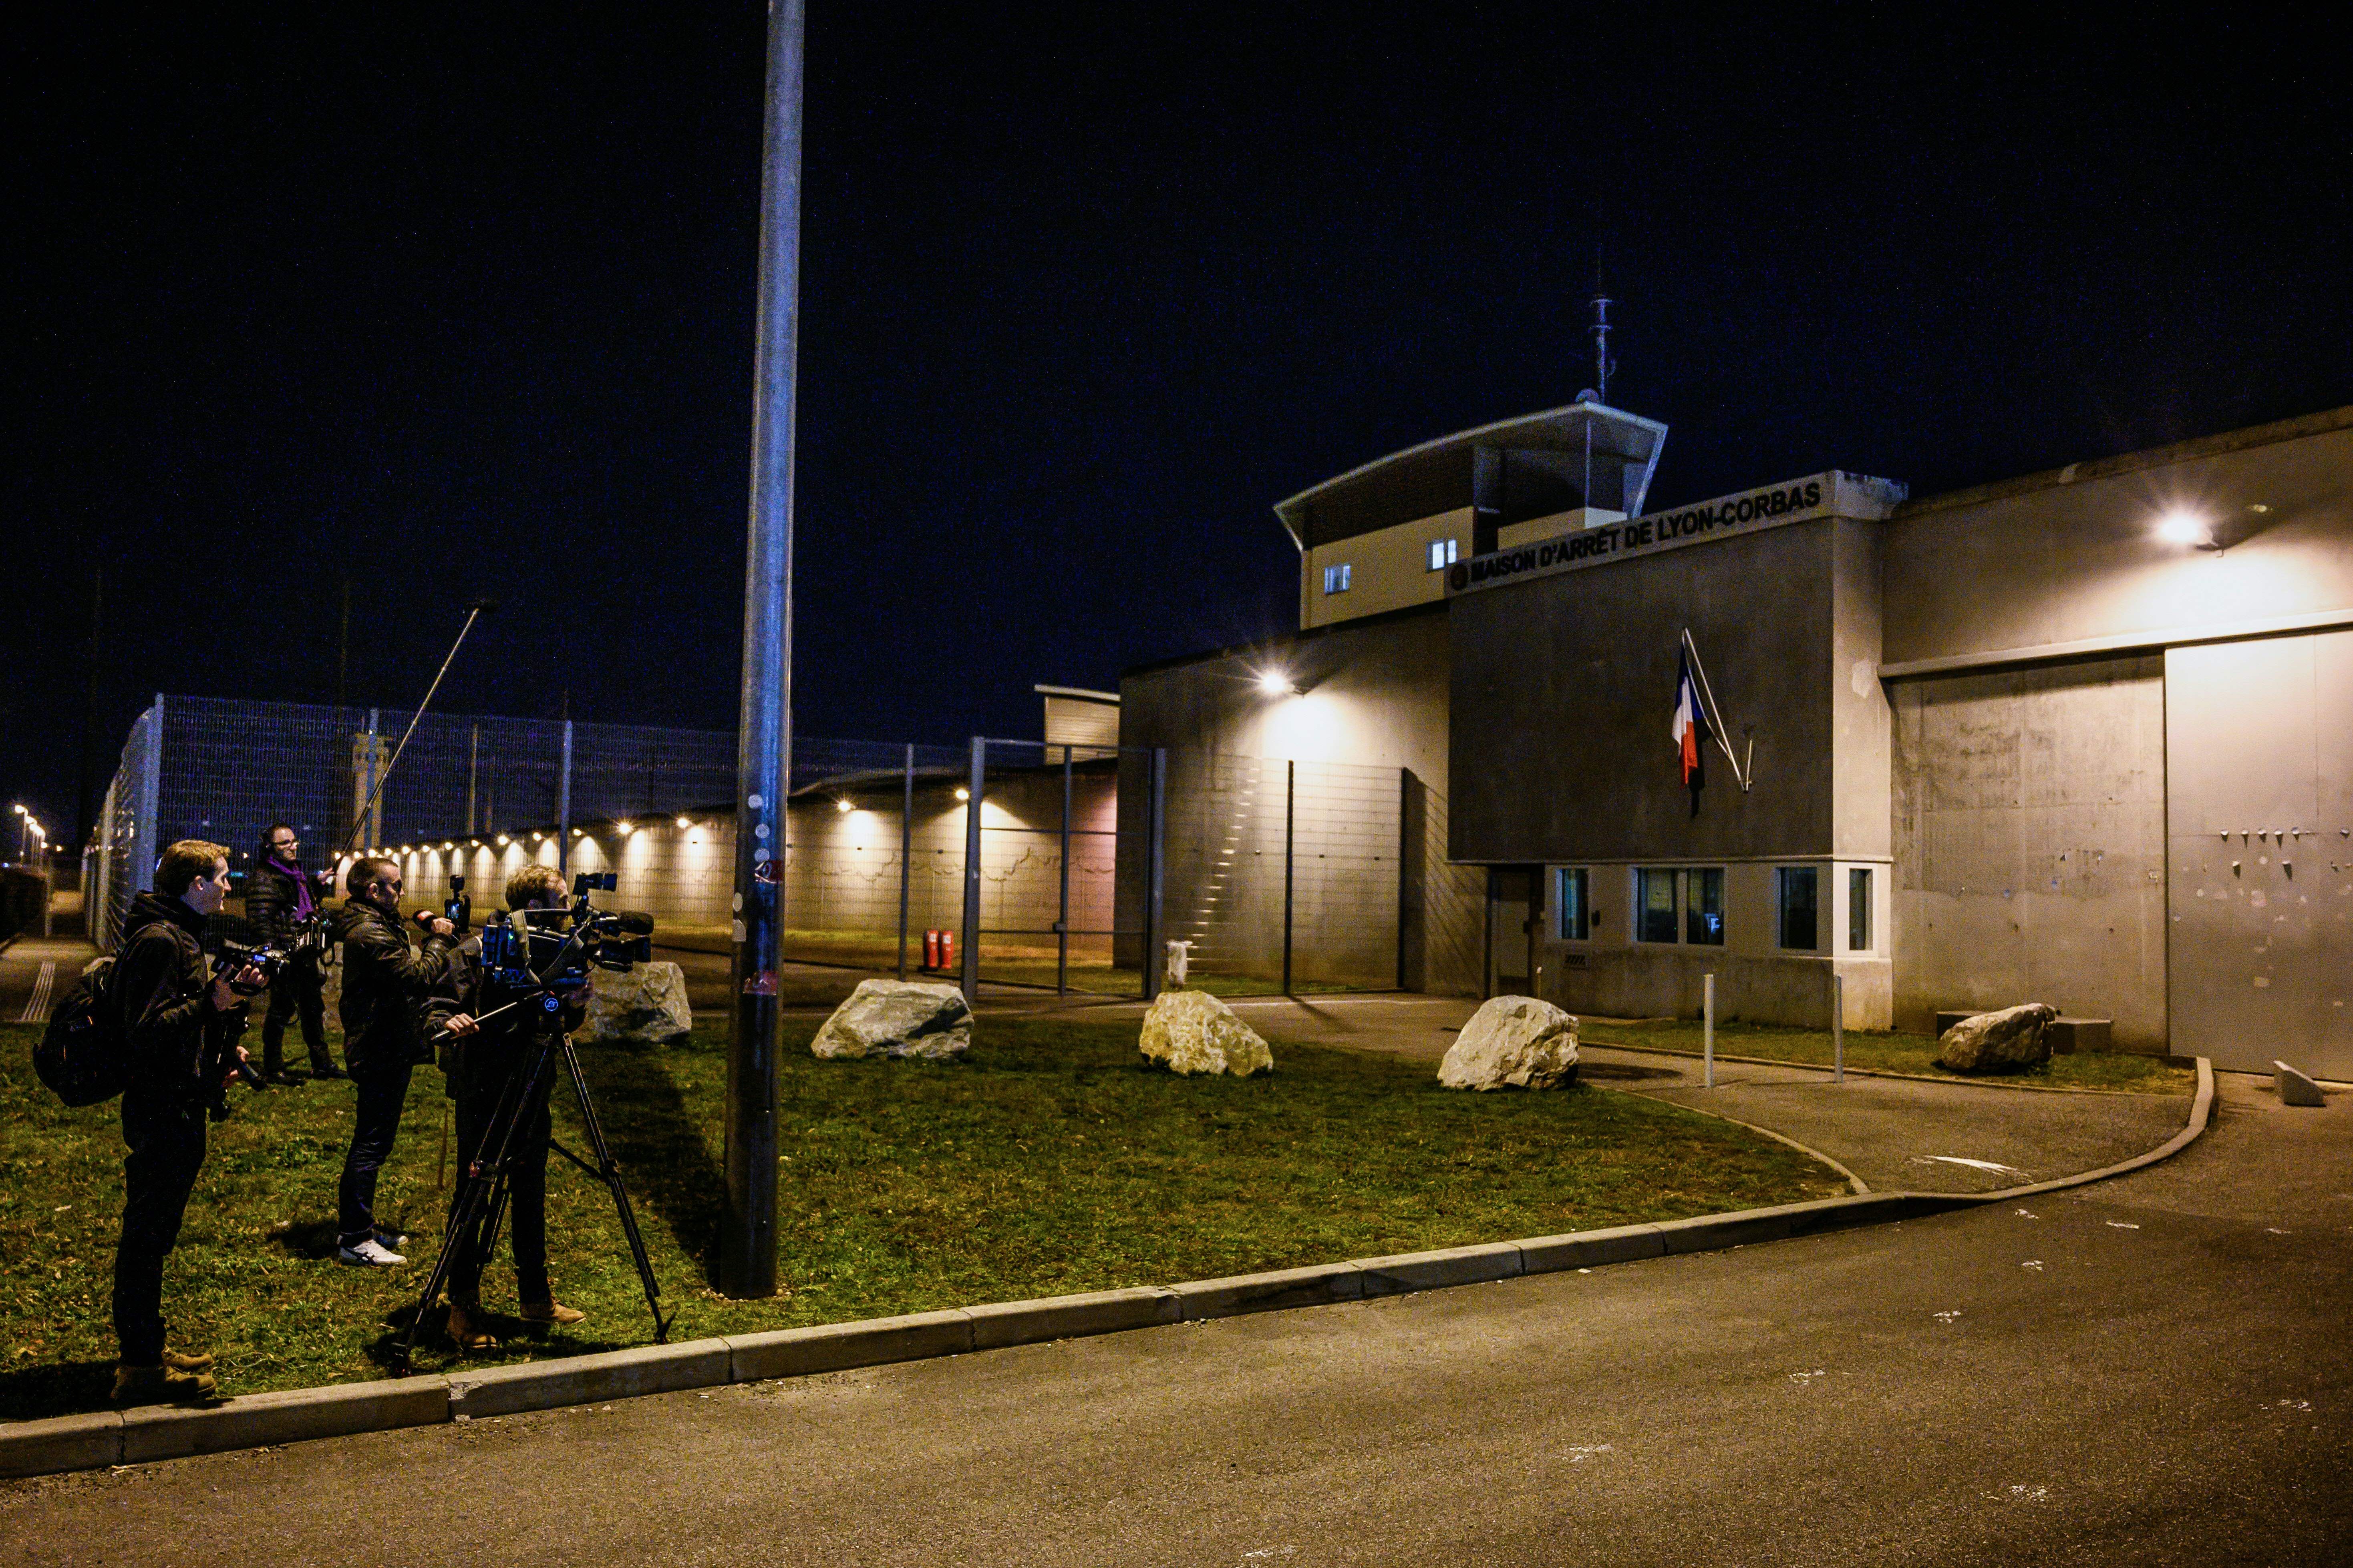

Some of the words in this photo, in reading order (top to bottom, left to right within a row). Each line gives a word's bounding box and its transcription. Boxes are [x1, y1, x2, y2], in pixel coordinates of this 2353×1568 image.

[1471, 549, 1536, 582] MAISON
[1625, 522, 1652, 548] DE
[1657, 482, 1820, 541] LYON-CORBAS
